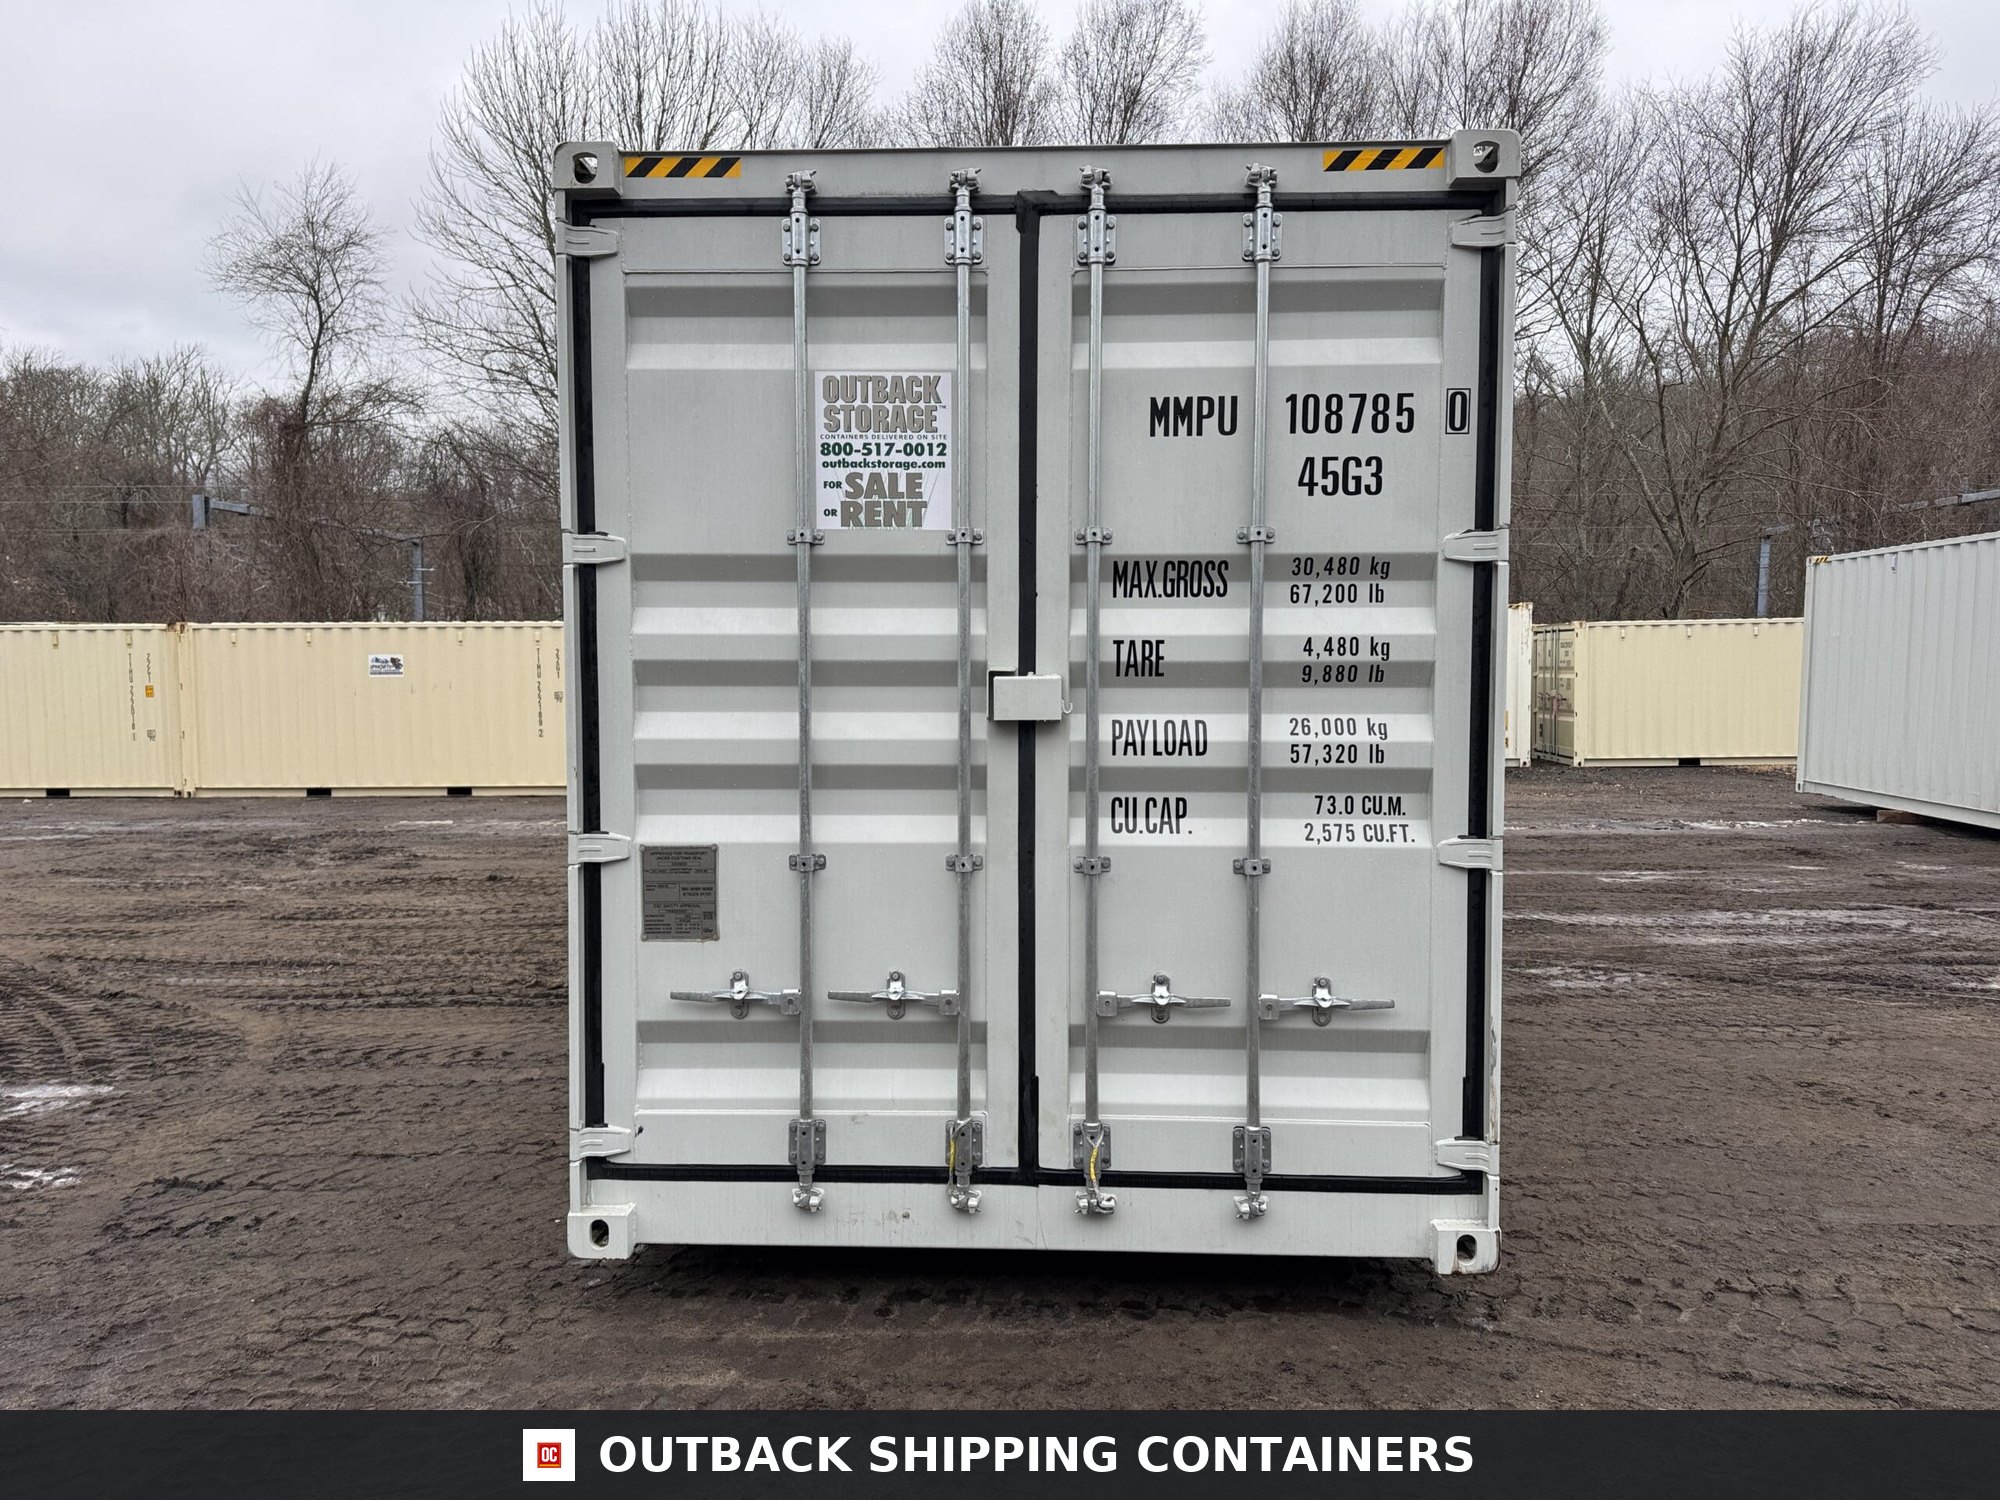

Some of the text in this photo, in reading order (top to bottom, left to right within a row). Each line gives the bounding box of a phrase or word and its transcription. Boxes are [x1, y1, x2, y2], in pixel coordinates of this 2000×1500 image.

[822, 375, 942, 403] OUTBACK
[823, 404, 938, 433] STORAGE
[1149, 390, 1467, 437] MMPU 108785 0
[820, 442, 947, 457] 800-517-0012
[822, 458, 946, 470] outbackstorage.com
[1297, 456, 1383, 497] 45G3
[823, 472, 923, 499] FOR SALE
[823, 500, 928, 528] OR RENT
[1112, 559, 1229, 599] MAX.GROSS
[1291, 556, 1391, 580] 30,480 kg
[1289, 583, 1385, 607] 67,200 lb
[1112, 639, 1165, 678] TARE
[1303, 636, 1391, 661] 4,480 kg
[1301, 664, 1385, 686] 9,880 lb
[1111, 719, 1209, 757] PAYLOAD
[1288, 717, 1388, 741] 26,000 kg
[1289, 744, 1385, 766] 57,320 lb
[1110, 797, 1193, 835] CU.CAP.
[1313, 795, 1407, 816] 73.0 CU.M.
[1304, 823, 1416, 845] 2,575 CU.FT.
